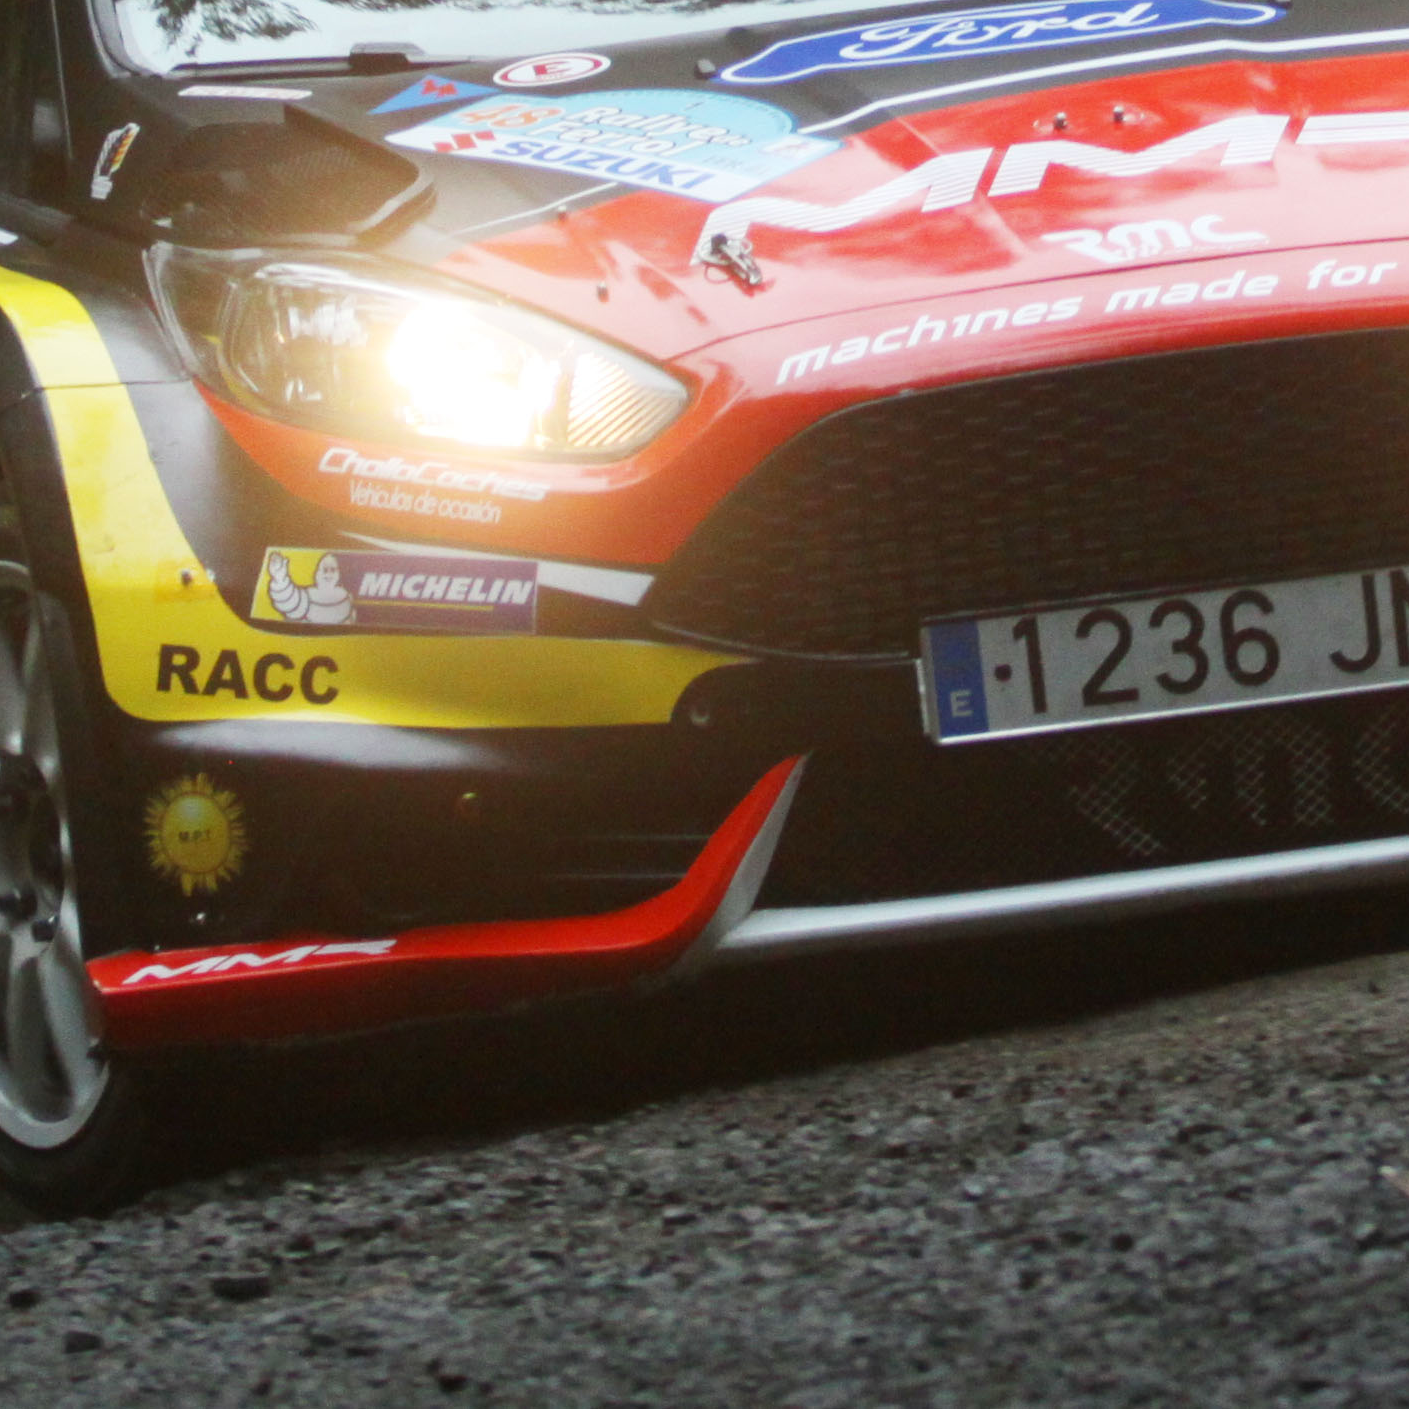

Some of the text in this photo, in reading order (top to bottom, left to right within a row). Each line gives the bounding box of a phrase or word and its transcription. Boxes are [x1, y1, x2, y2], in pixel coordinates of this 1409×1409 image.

[839, 0, 1161, 62] Ford
[456, 103, 565, 128] 48
[563, 106, 731, 139] Rallye
[526, 120, 708, 157] Ferrol
[491, 141, 716, 189] SUZUKI
[774, 295, 1081, 386] machines
[1104, 260, 1279, 315] made
[1307, 258, 1398, 292] for
[413, 489, 438, 516] de
[357, 570, 535, 606] MICHELIN
[1011, 589, 1282, 715] 1236
[154, 643, 341, 706] RACC
[949, 689, 973, 719] E
[122, 939, 398, 986] MMR
